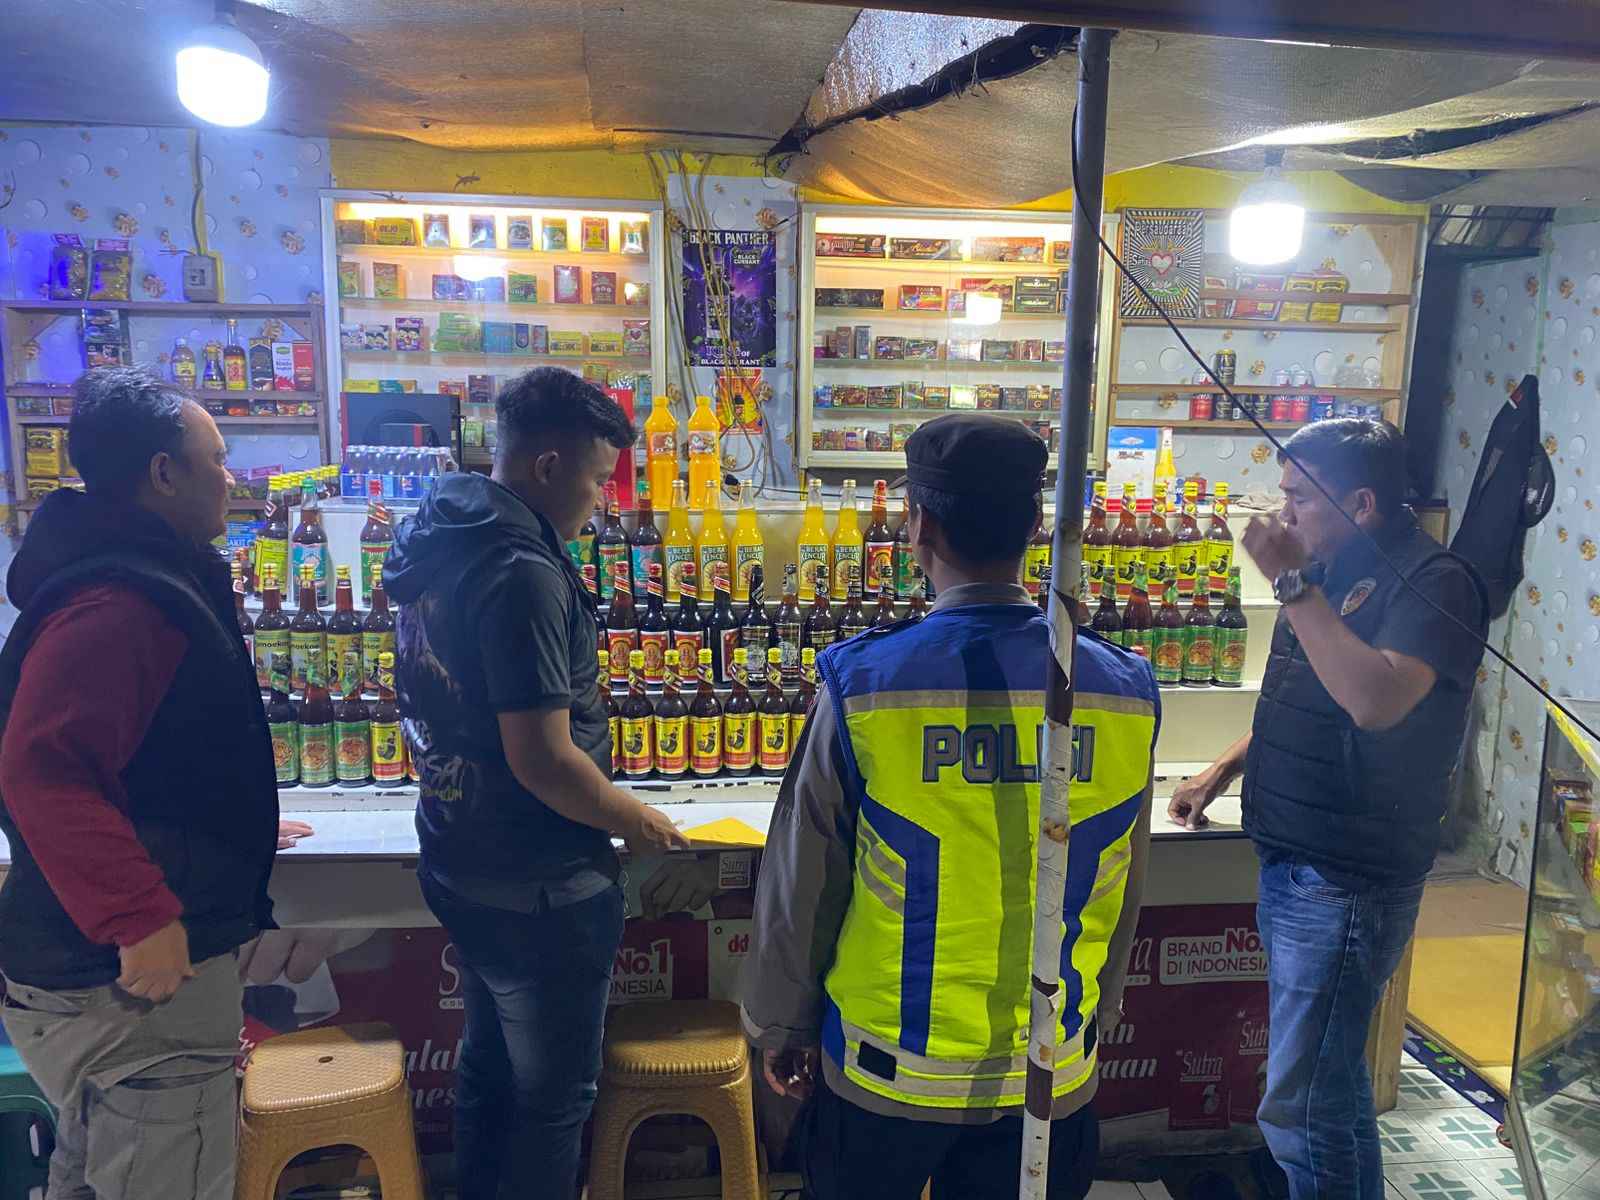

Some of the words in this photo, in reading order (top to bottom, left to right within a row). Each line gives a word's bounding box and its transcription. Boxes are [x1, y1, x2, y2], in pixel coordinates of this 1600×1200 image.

[725, 232, 769, 245] PANTHER
[922, 724, 1096, 783] POLI
[1167, 941, 1223, 957] BRAND
[1167, 960, 1182, 975] DI
